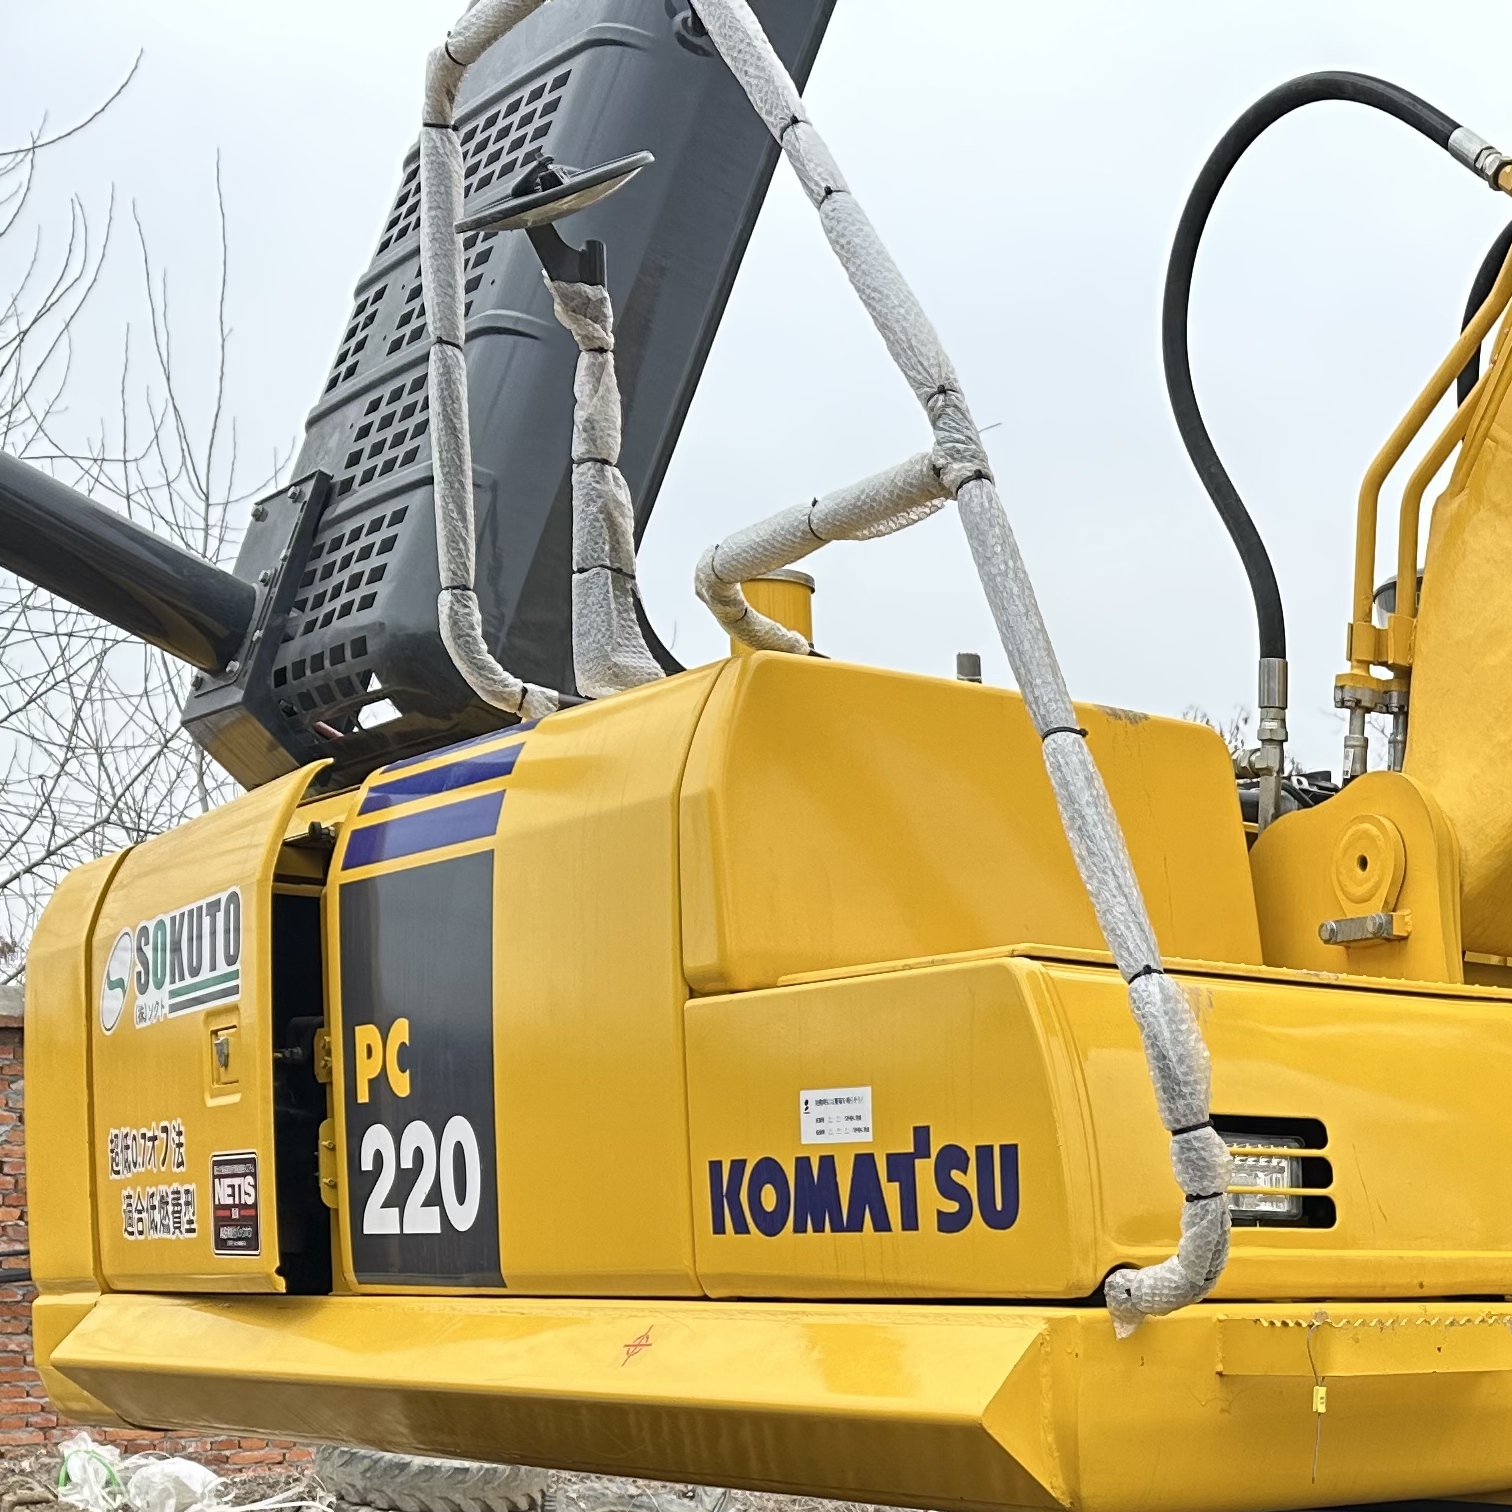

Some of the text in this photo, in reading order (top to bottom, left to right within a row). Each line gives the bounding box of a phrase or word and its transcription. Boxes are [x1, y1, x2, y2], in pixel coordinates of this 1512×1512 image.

[136, 891, 240, 995] SOKUTO
[355, 1018, 410, 1103] PC
[214, 1175, 255, 1205] NETIS
[361, 1115, 481, 1234] 220
[708, 1125, 1020, 1237] KOMATSU
